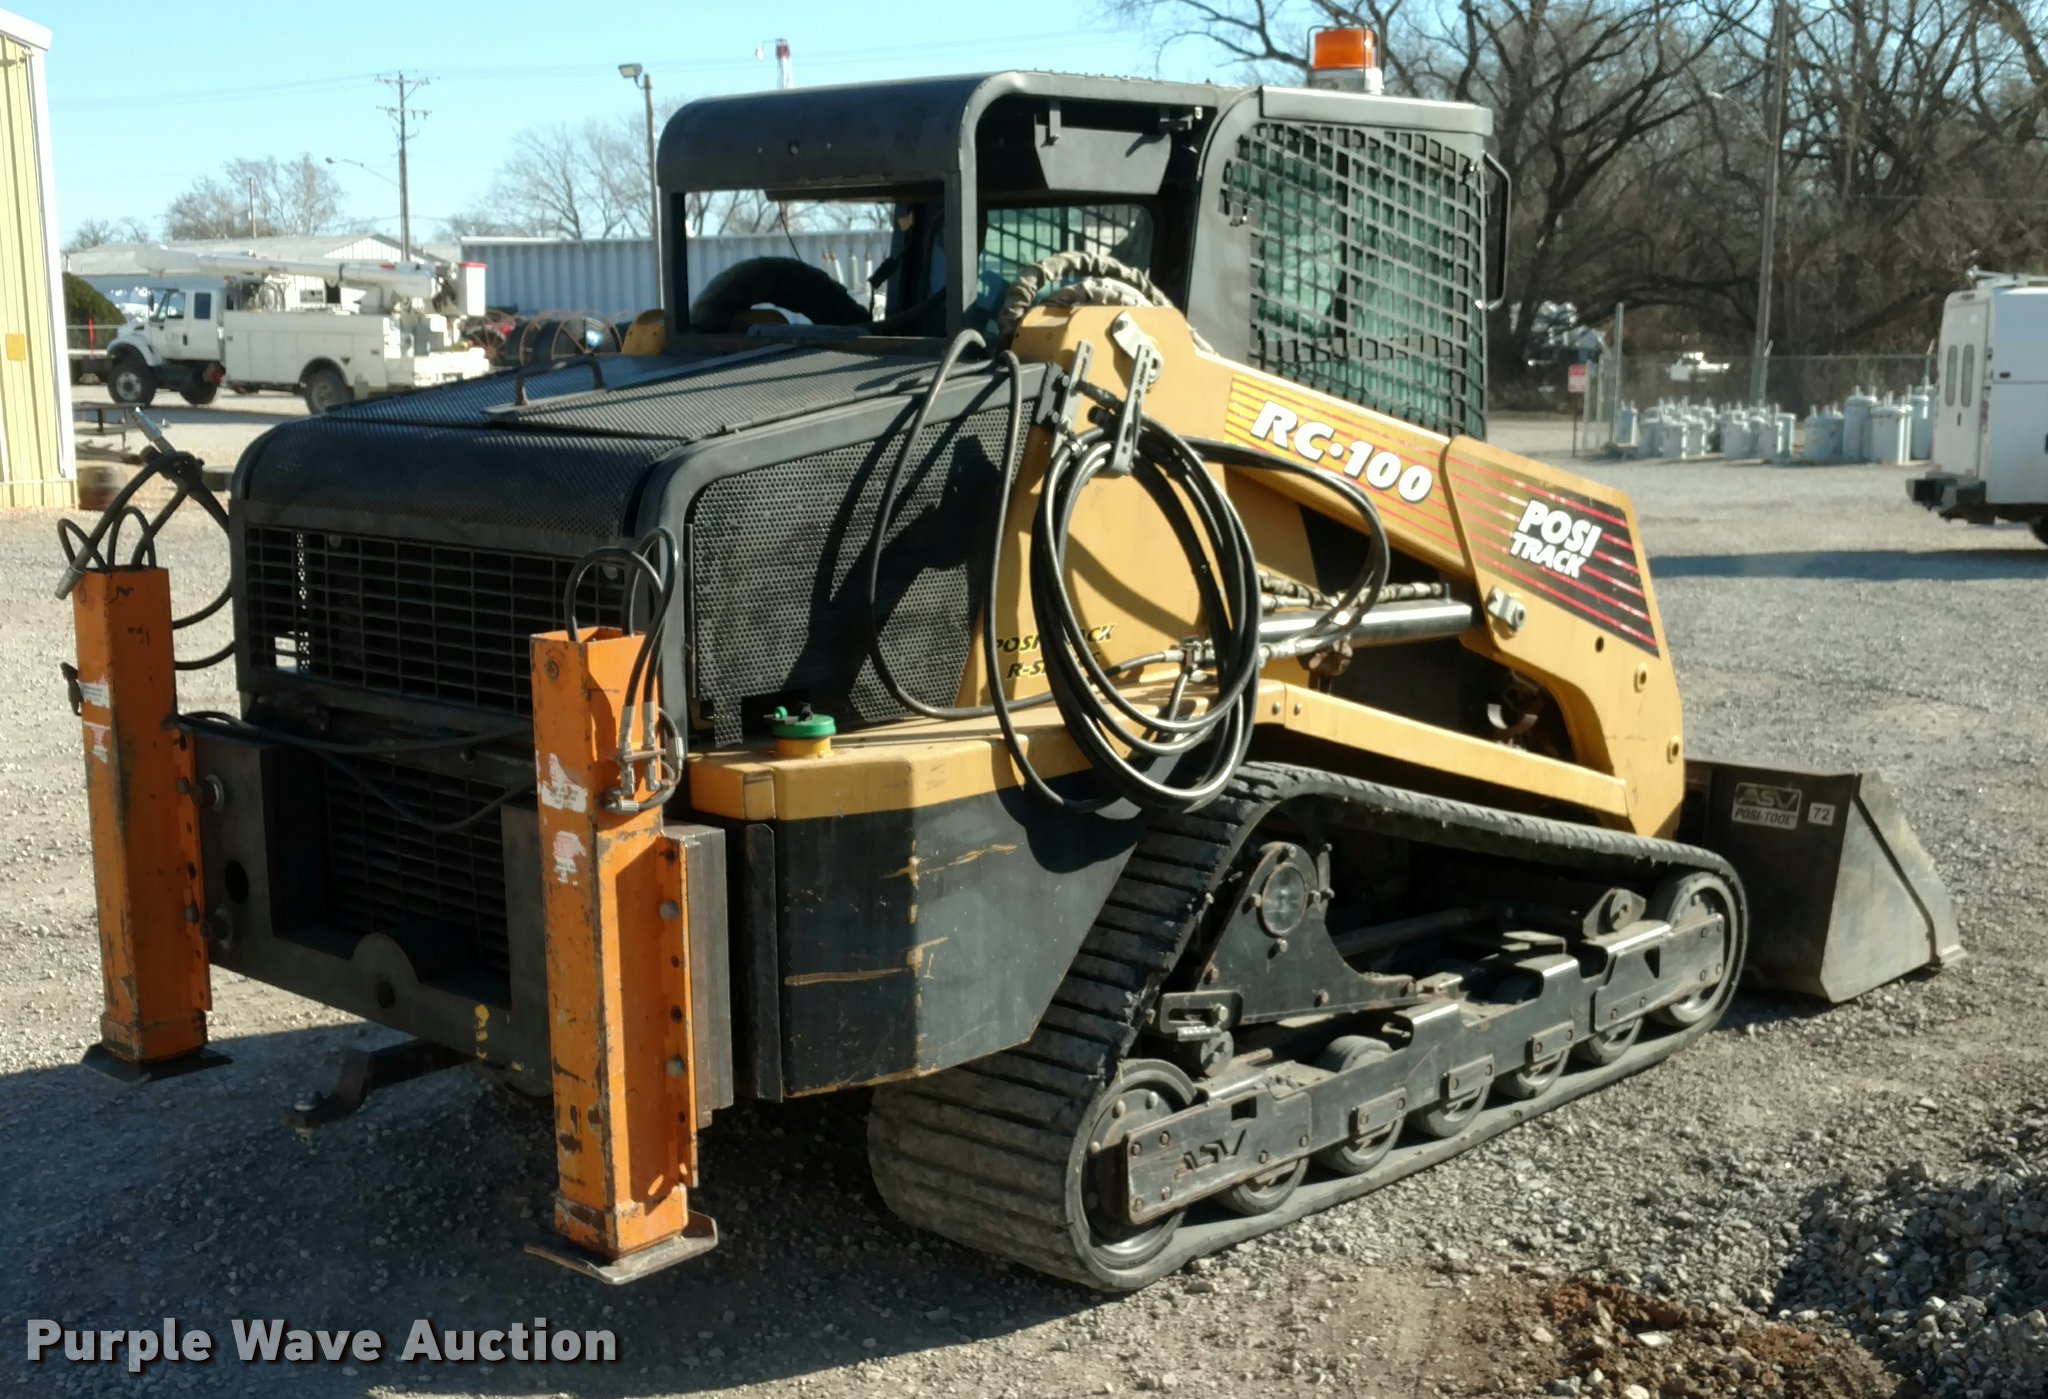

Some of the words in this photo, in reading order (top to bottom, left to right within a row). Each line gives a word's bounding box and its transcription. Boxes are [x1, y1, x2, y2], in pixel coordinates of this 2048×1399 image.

[1517, 499, 1602, 558] POSI
[1510, 531, 1587, 578] TRACK
[1738, 787, 1798, 810] ASV
[1734, 806, 1793, 825] POSI-TOOL
[1813, 806, 1831, 821] 72
